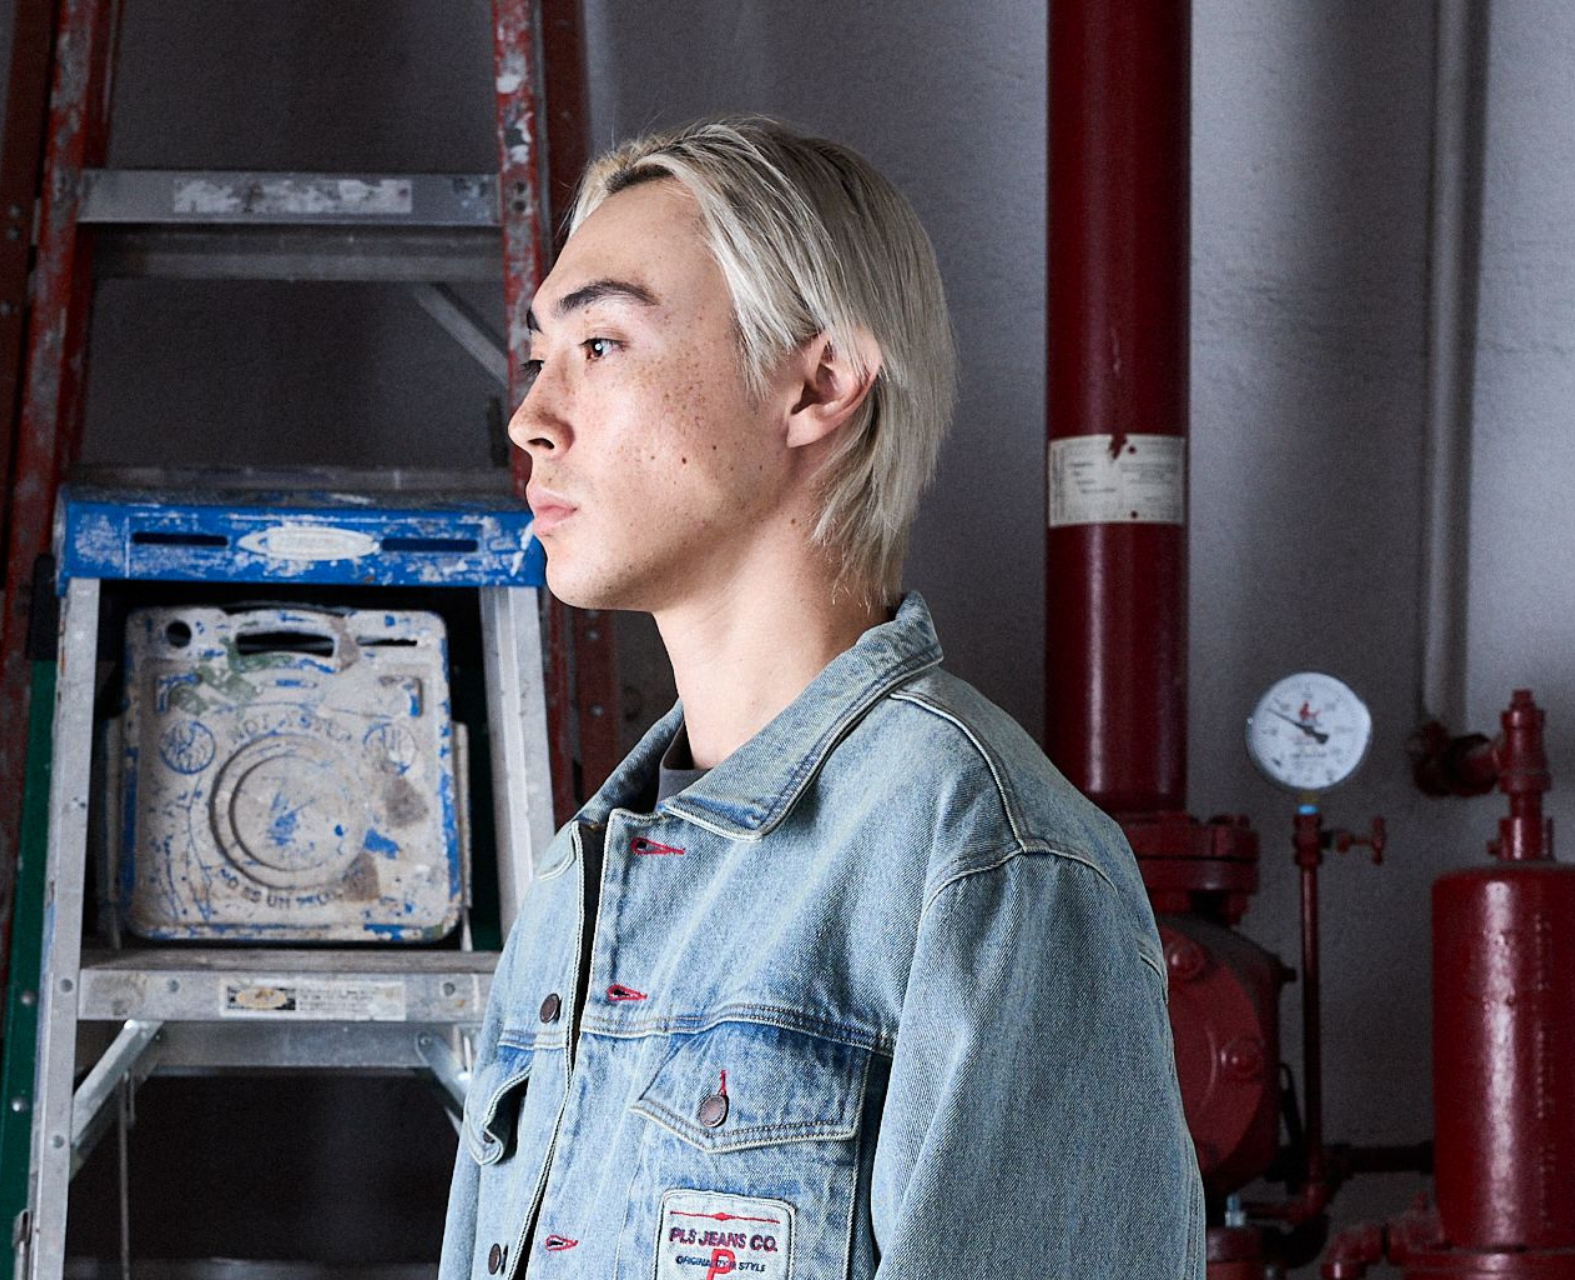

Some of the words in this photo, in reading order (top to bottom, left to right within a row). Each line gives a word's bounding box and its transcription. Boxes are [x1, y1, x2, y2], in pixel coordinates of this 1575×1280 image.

[669, 1227, 697, 1245] PLS
[698, 1230, 747, 1249] JEANS
[738, 1261, 766, 1272] STYLE
